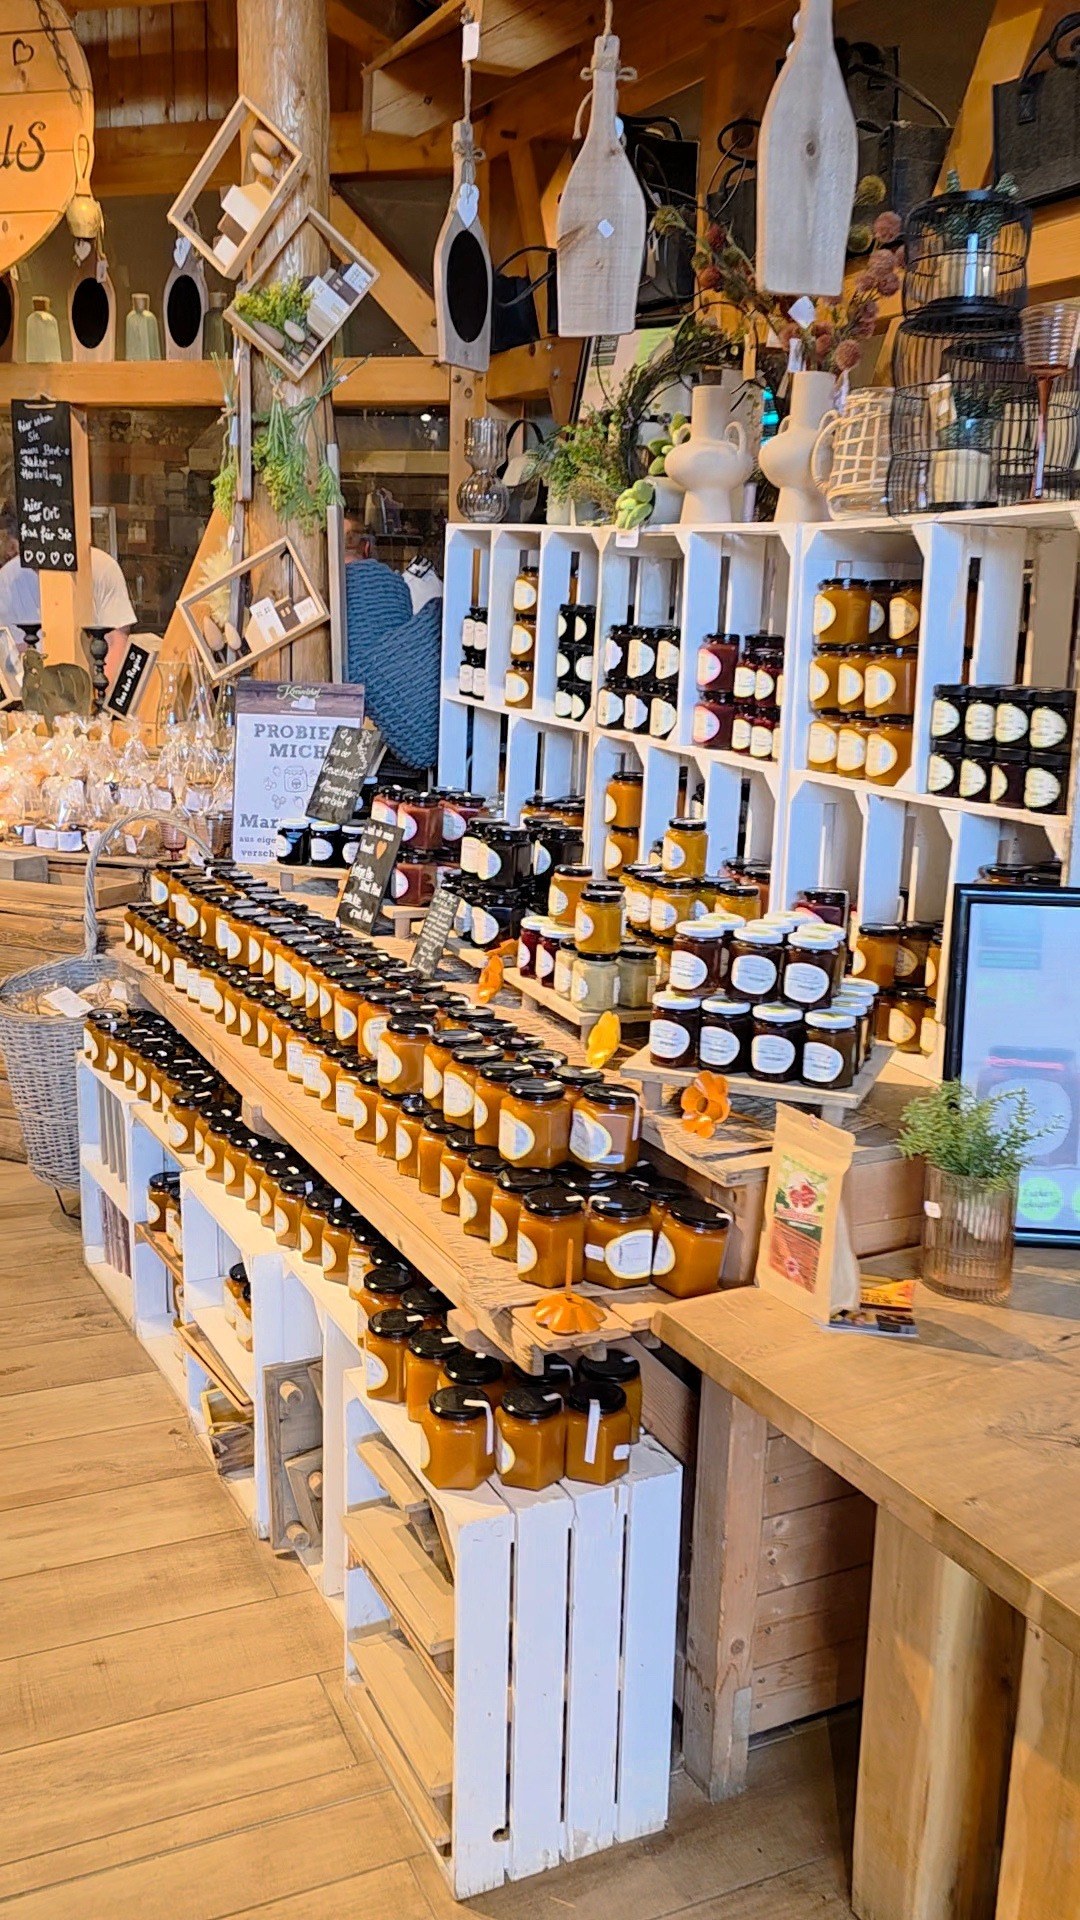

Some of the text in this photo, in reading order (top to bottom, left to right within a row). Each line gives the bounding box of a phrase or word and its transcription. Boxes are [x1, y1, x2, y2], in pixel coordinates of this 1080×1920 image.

[43, 506, 60, 521] Ort
[40, 525, 56, 544] für
[58, 528, 72, 542] Sie
[254, 723, 335, 740] PROBIE
[269, 743, 326, 759] MICH
[240, 814, 281, 829] Mar
[257, 835, 277, 846] eige
[241, 849, 277, 858] versch
